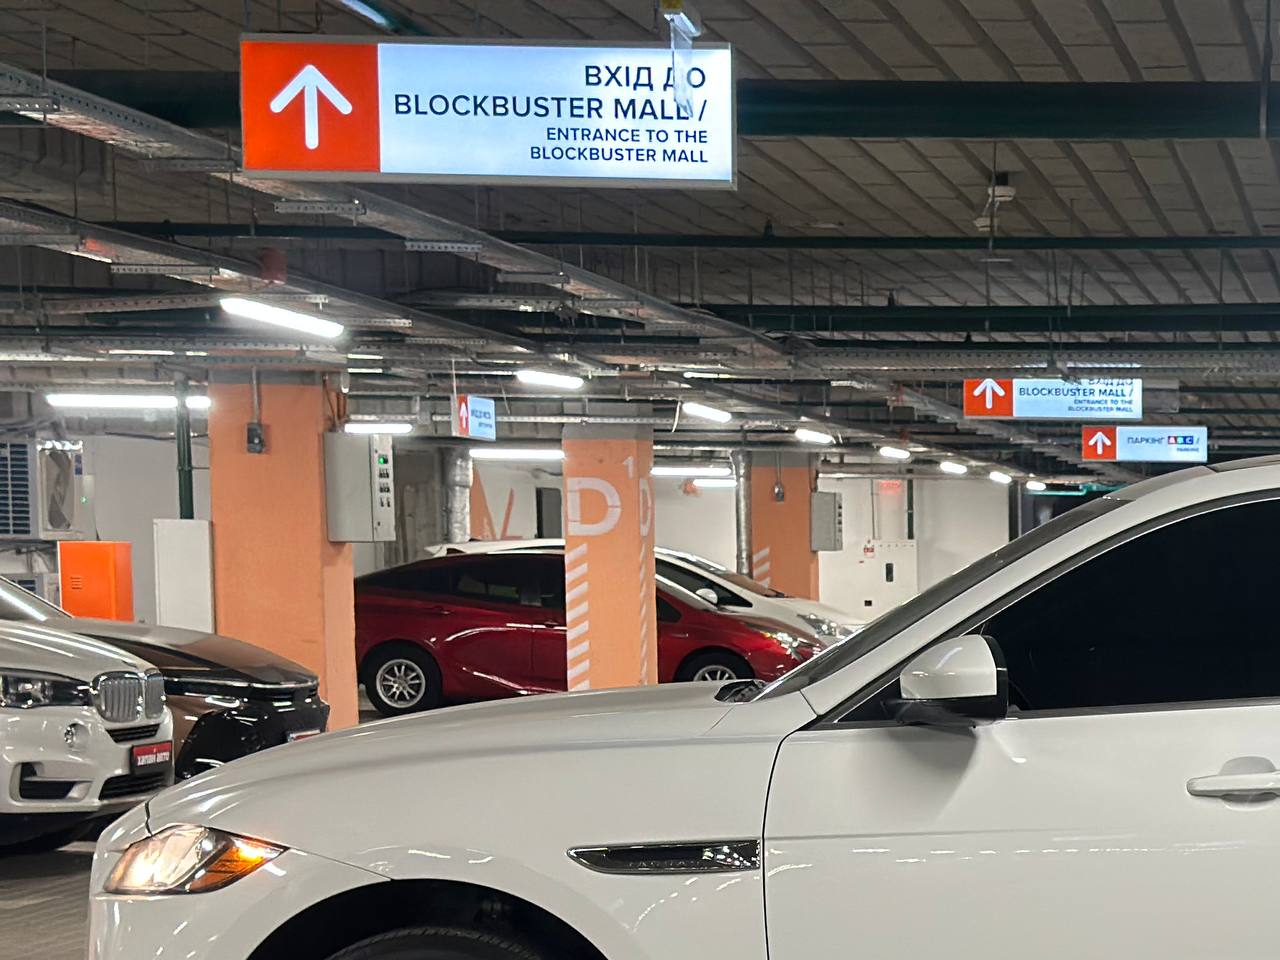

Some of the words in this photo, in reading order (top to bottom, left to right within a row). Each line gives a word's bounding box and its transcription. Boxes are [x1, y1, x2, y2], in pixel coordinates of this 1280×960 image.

[585, 64, 654, 91] ВХІД
[394, 93, 602, 119] BLOCKBUSTER
[614, 98, 690, 120] MALL
[546, 127, 641, 142] ENTRANCE
[646, 129, 669, 143] TO
[674, 130, 708, 143] THE
[530, 146, 657, 162] BLOCKBUSTER
[662, 149, 708, 163] MALL
[1019, 387, 1095, 397] BLOCKBUSTER
[1099, 388, 1127, 397] MALL
